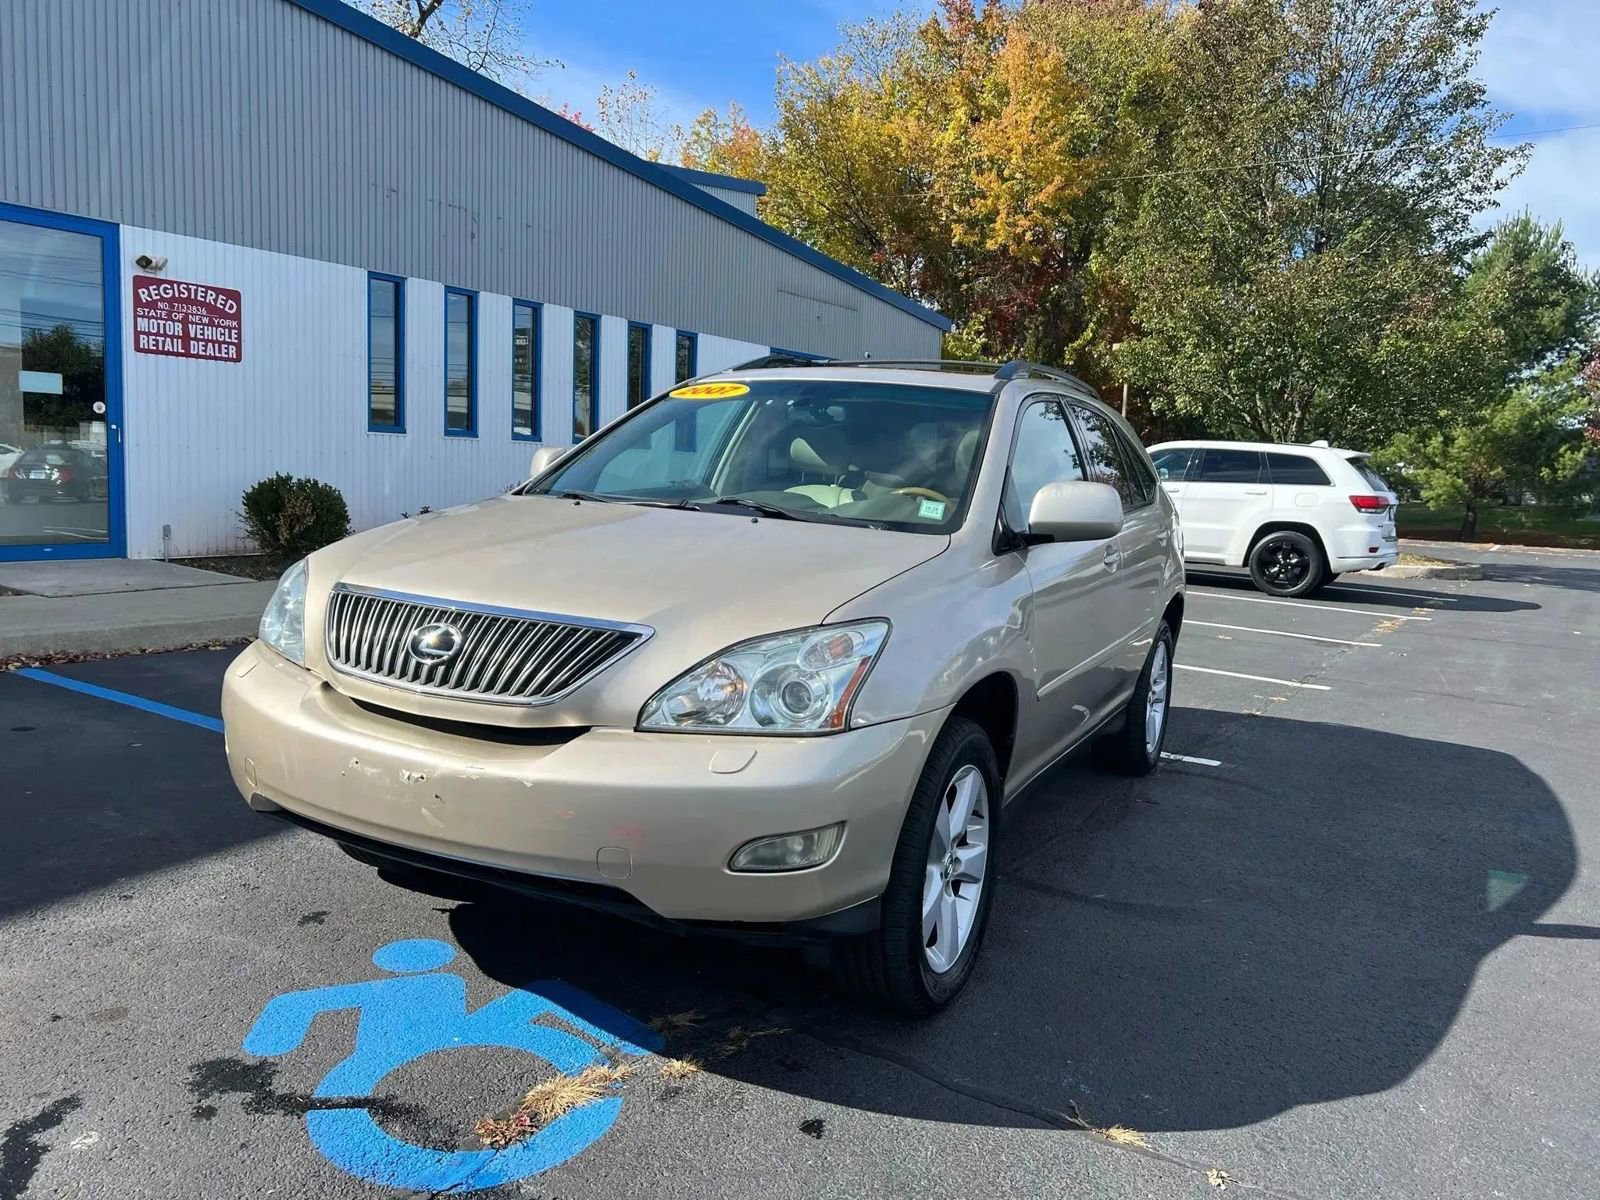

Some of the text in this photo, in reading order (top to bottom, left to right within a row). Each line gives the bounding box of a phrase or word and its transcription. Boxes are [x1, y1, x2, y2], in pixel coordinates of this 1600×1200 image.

[138, 284, 237, 314] REGISTERED
[157, 302, 170, 311] NO.
[137, 308, 239, 328] STATE OF NEW YORK
[137, 318, 239, 343] MOTOR VEHICLE
[140, 335, 237, 359] RETAIL DEALER
[675, 386, 744, 395] 2007
